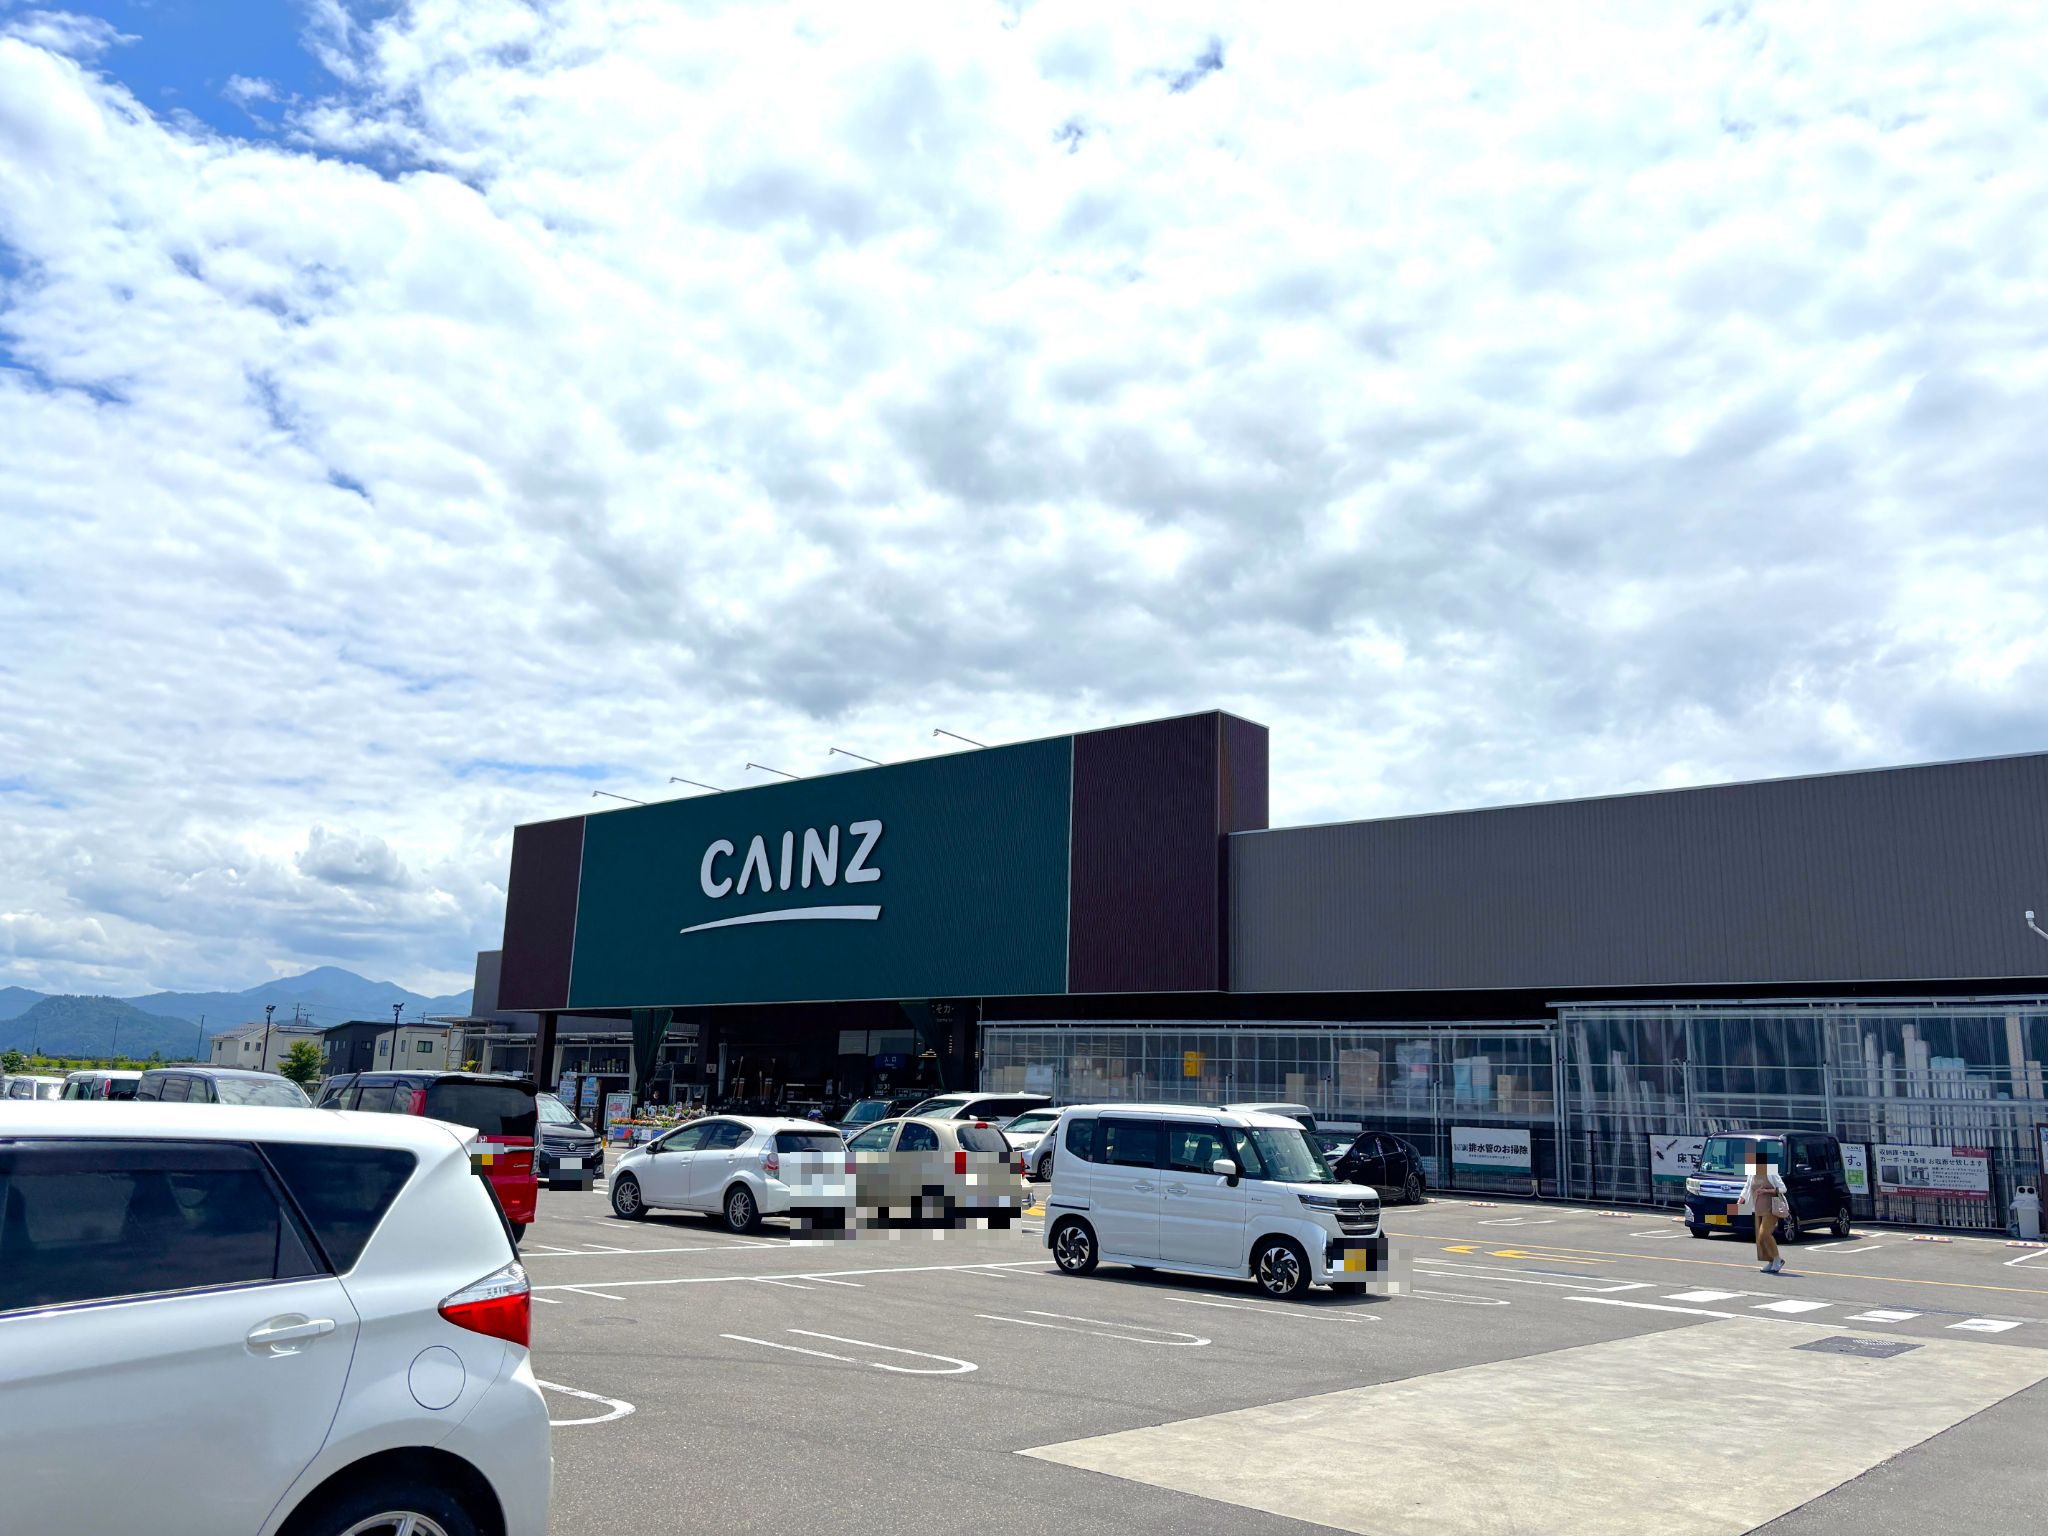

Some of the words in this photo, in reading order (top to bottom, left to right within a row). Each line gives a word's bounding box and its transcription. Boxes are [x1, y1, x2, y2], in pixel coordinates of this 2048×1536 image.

[700, 819, 883, 899] CAINZ
[1469, 1143, 1528, 1155] 排水管のお掃除
[1677, 1153, 1702, 1163] 床下
